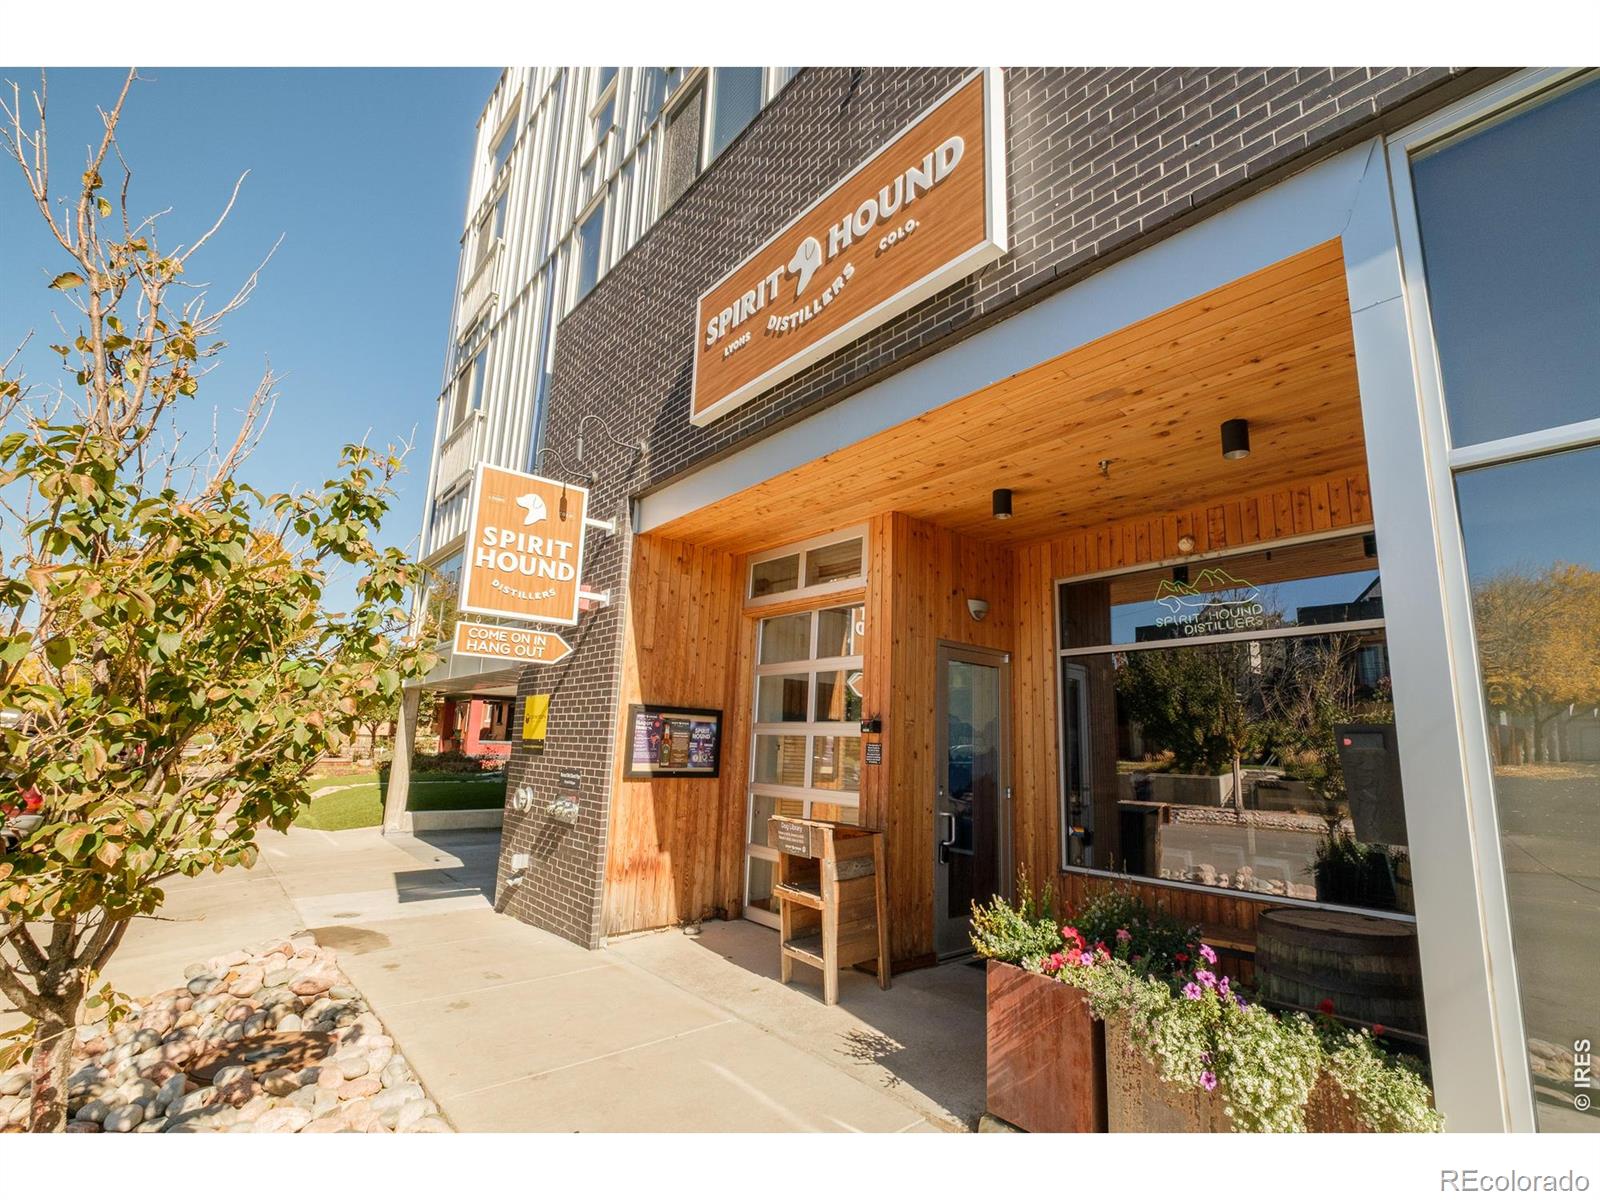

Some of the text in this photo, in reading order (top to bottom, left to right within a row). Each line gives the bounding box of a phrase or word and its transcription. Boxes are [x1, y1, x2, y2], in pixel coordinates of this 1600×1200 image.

[706, 135, 965, 346] SPIRIT HOUND
[878, 218, 921, 251] COLO.
[766, 262, 856, 333] DISTILLERS
[723, 331, 751, 358] LYONS
[482, 526, 574, 561] SPIRIT
[475, 547, 576, 582] HOUND
[491, 579, 558, 600] DISTILLERS
[1155, 603, 1264, 628] SPIRIT HOUND
[1184, 615, 1264, 635] DISTILLERS
[466, 639, 546, 658] HANG OUT
[468, 627, 547, 646] COME ON IN
